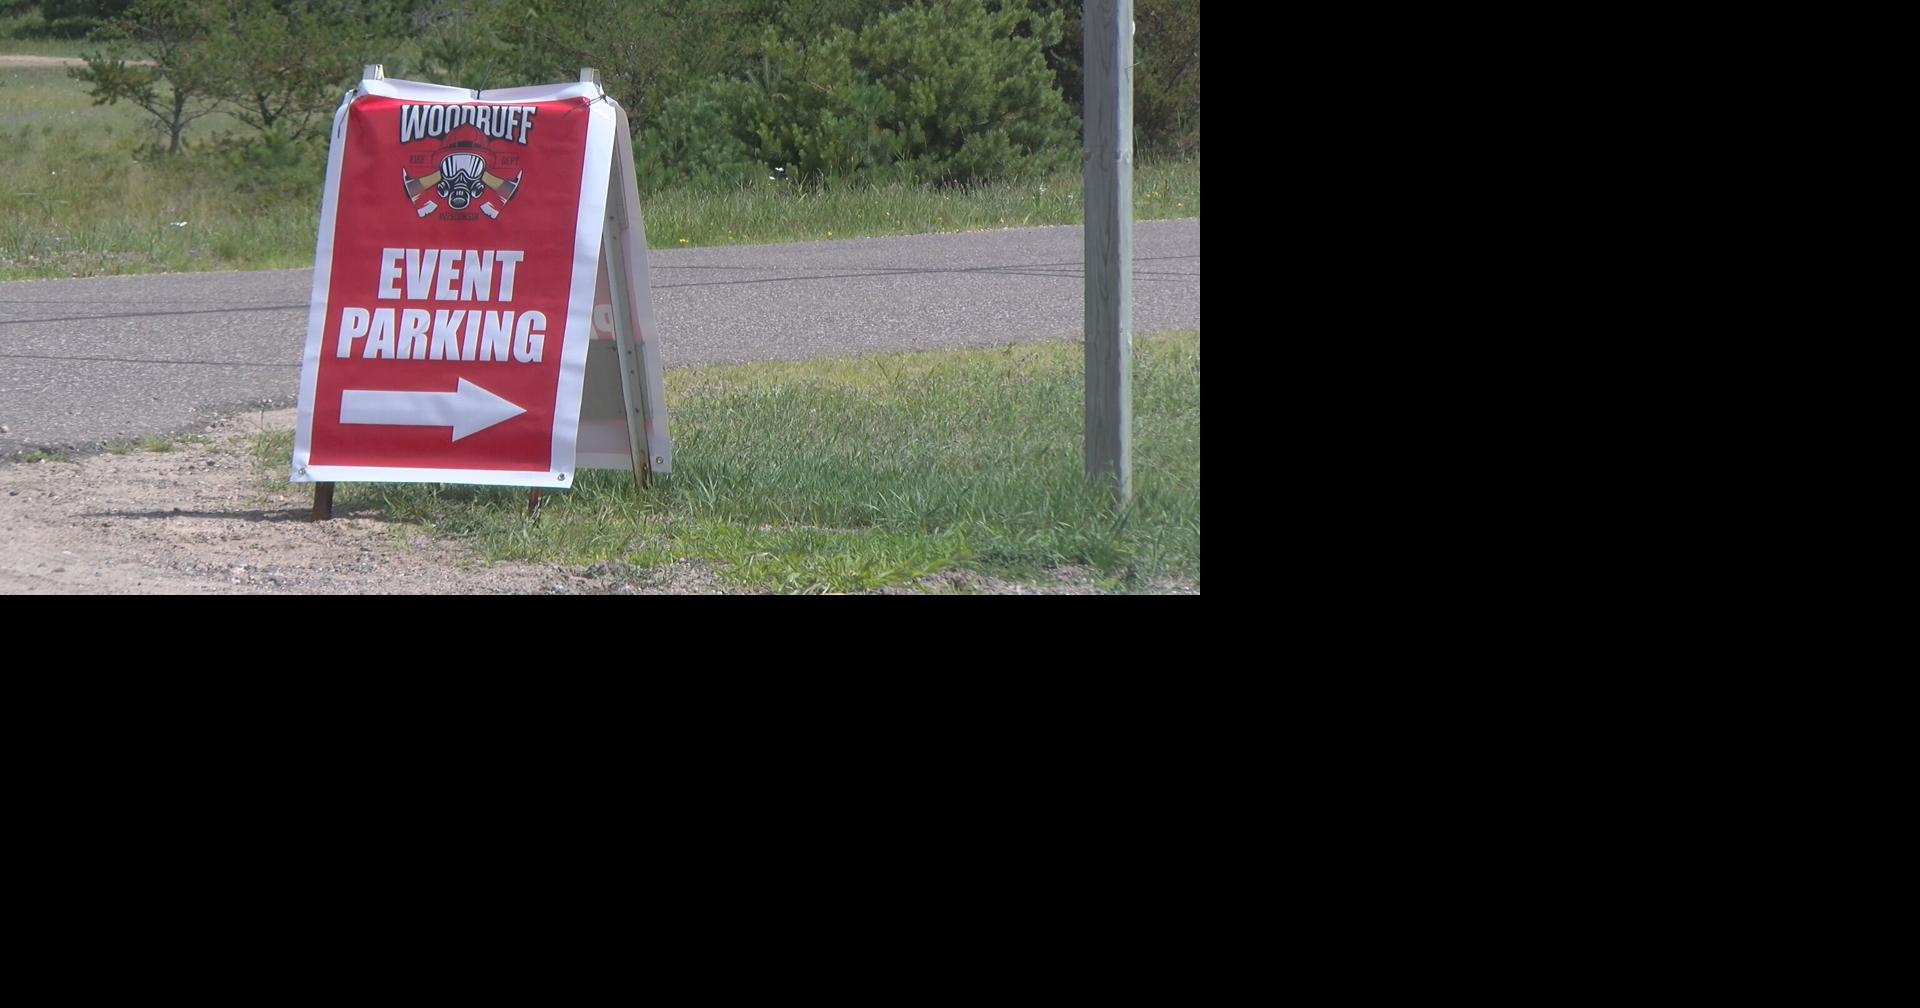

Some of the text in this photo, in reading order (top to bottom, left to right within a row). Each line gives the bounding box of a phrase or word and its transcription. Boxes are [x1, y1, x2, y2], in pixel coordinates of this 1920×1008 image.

[400, 104, 538, 145] WOODRUFF
[378, 248, 524, 302] EVENT
[336, 306, 547, 363] PARKING
